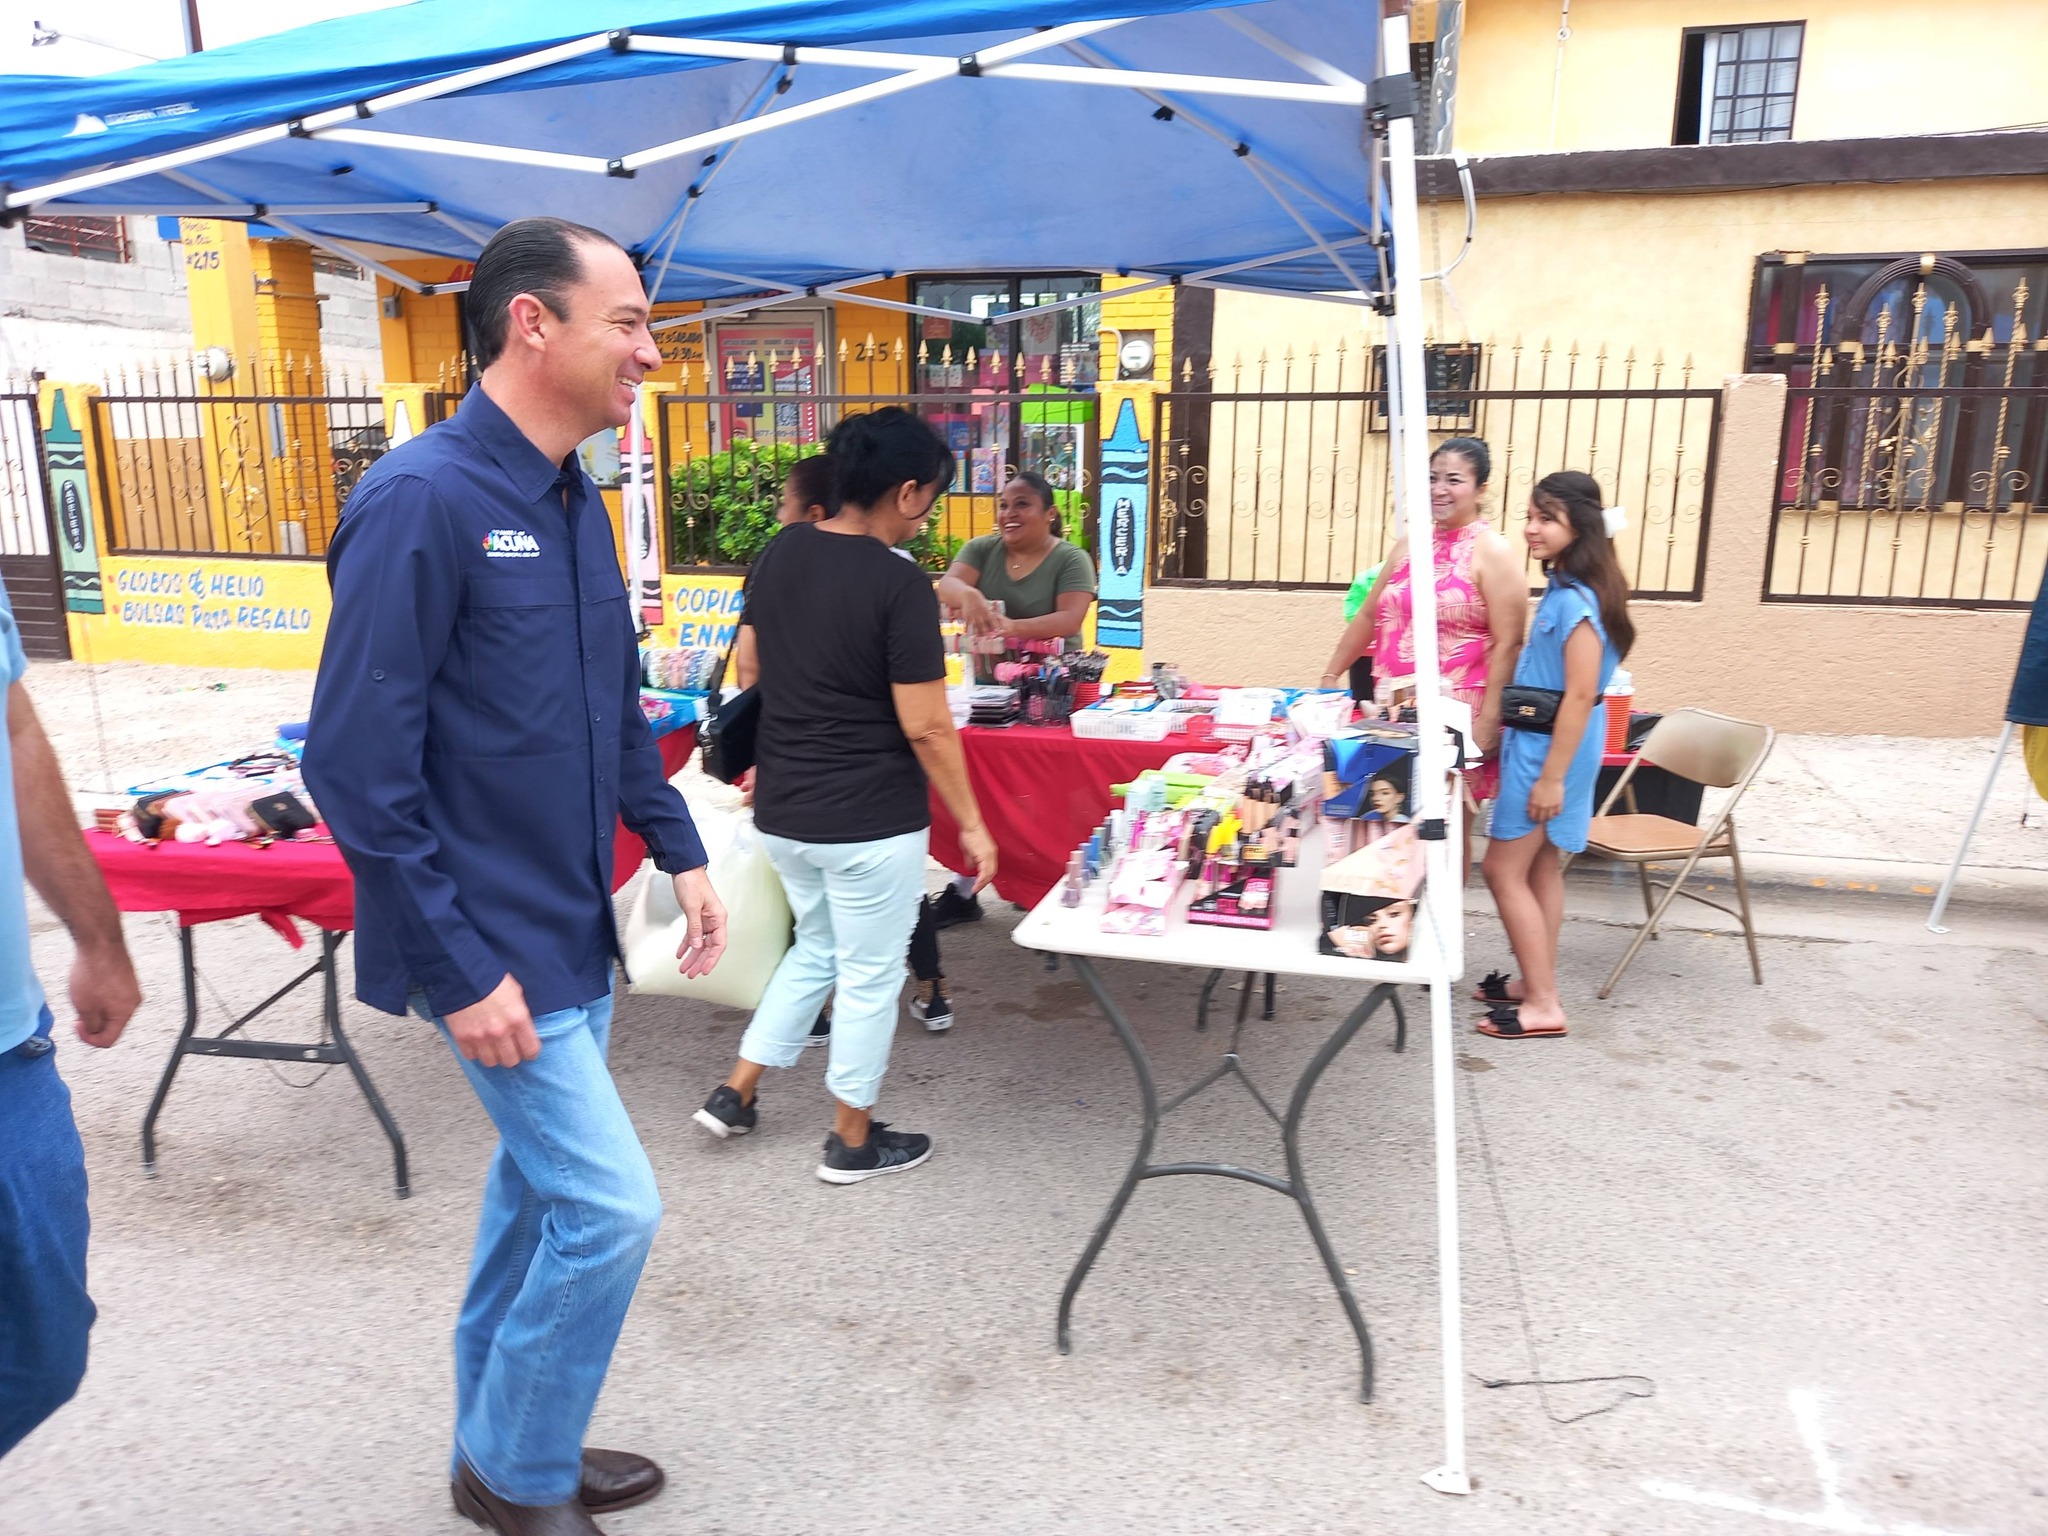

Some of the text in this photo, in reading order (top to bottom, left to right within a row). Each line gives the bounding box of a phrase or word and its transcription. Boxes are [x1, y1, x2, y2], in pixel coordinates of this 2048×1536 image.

[1114, 499, 1131, 575] MERCERIA
[118, 569, 183, 594] GLOBOS
[211, 575, 264, 597] HELIO
[676, 587, 746, 614] COPIA
[123, 601, 185, 625] BOLSAS
[236, 605, 311, 631] REGALO
[680, 623, 737, 647] ENM
